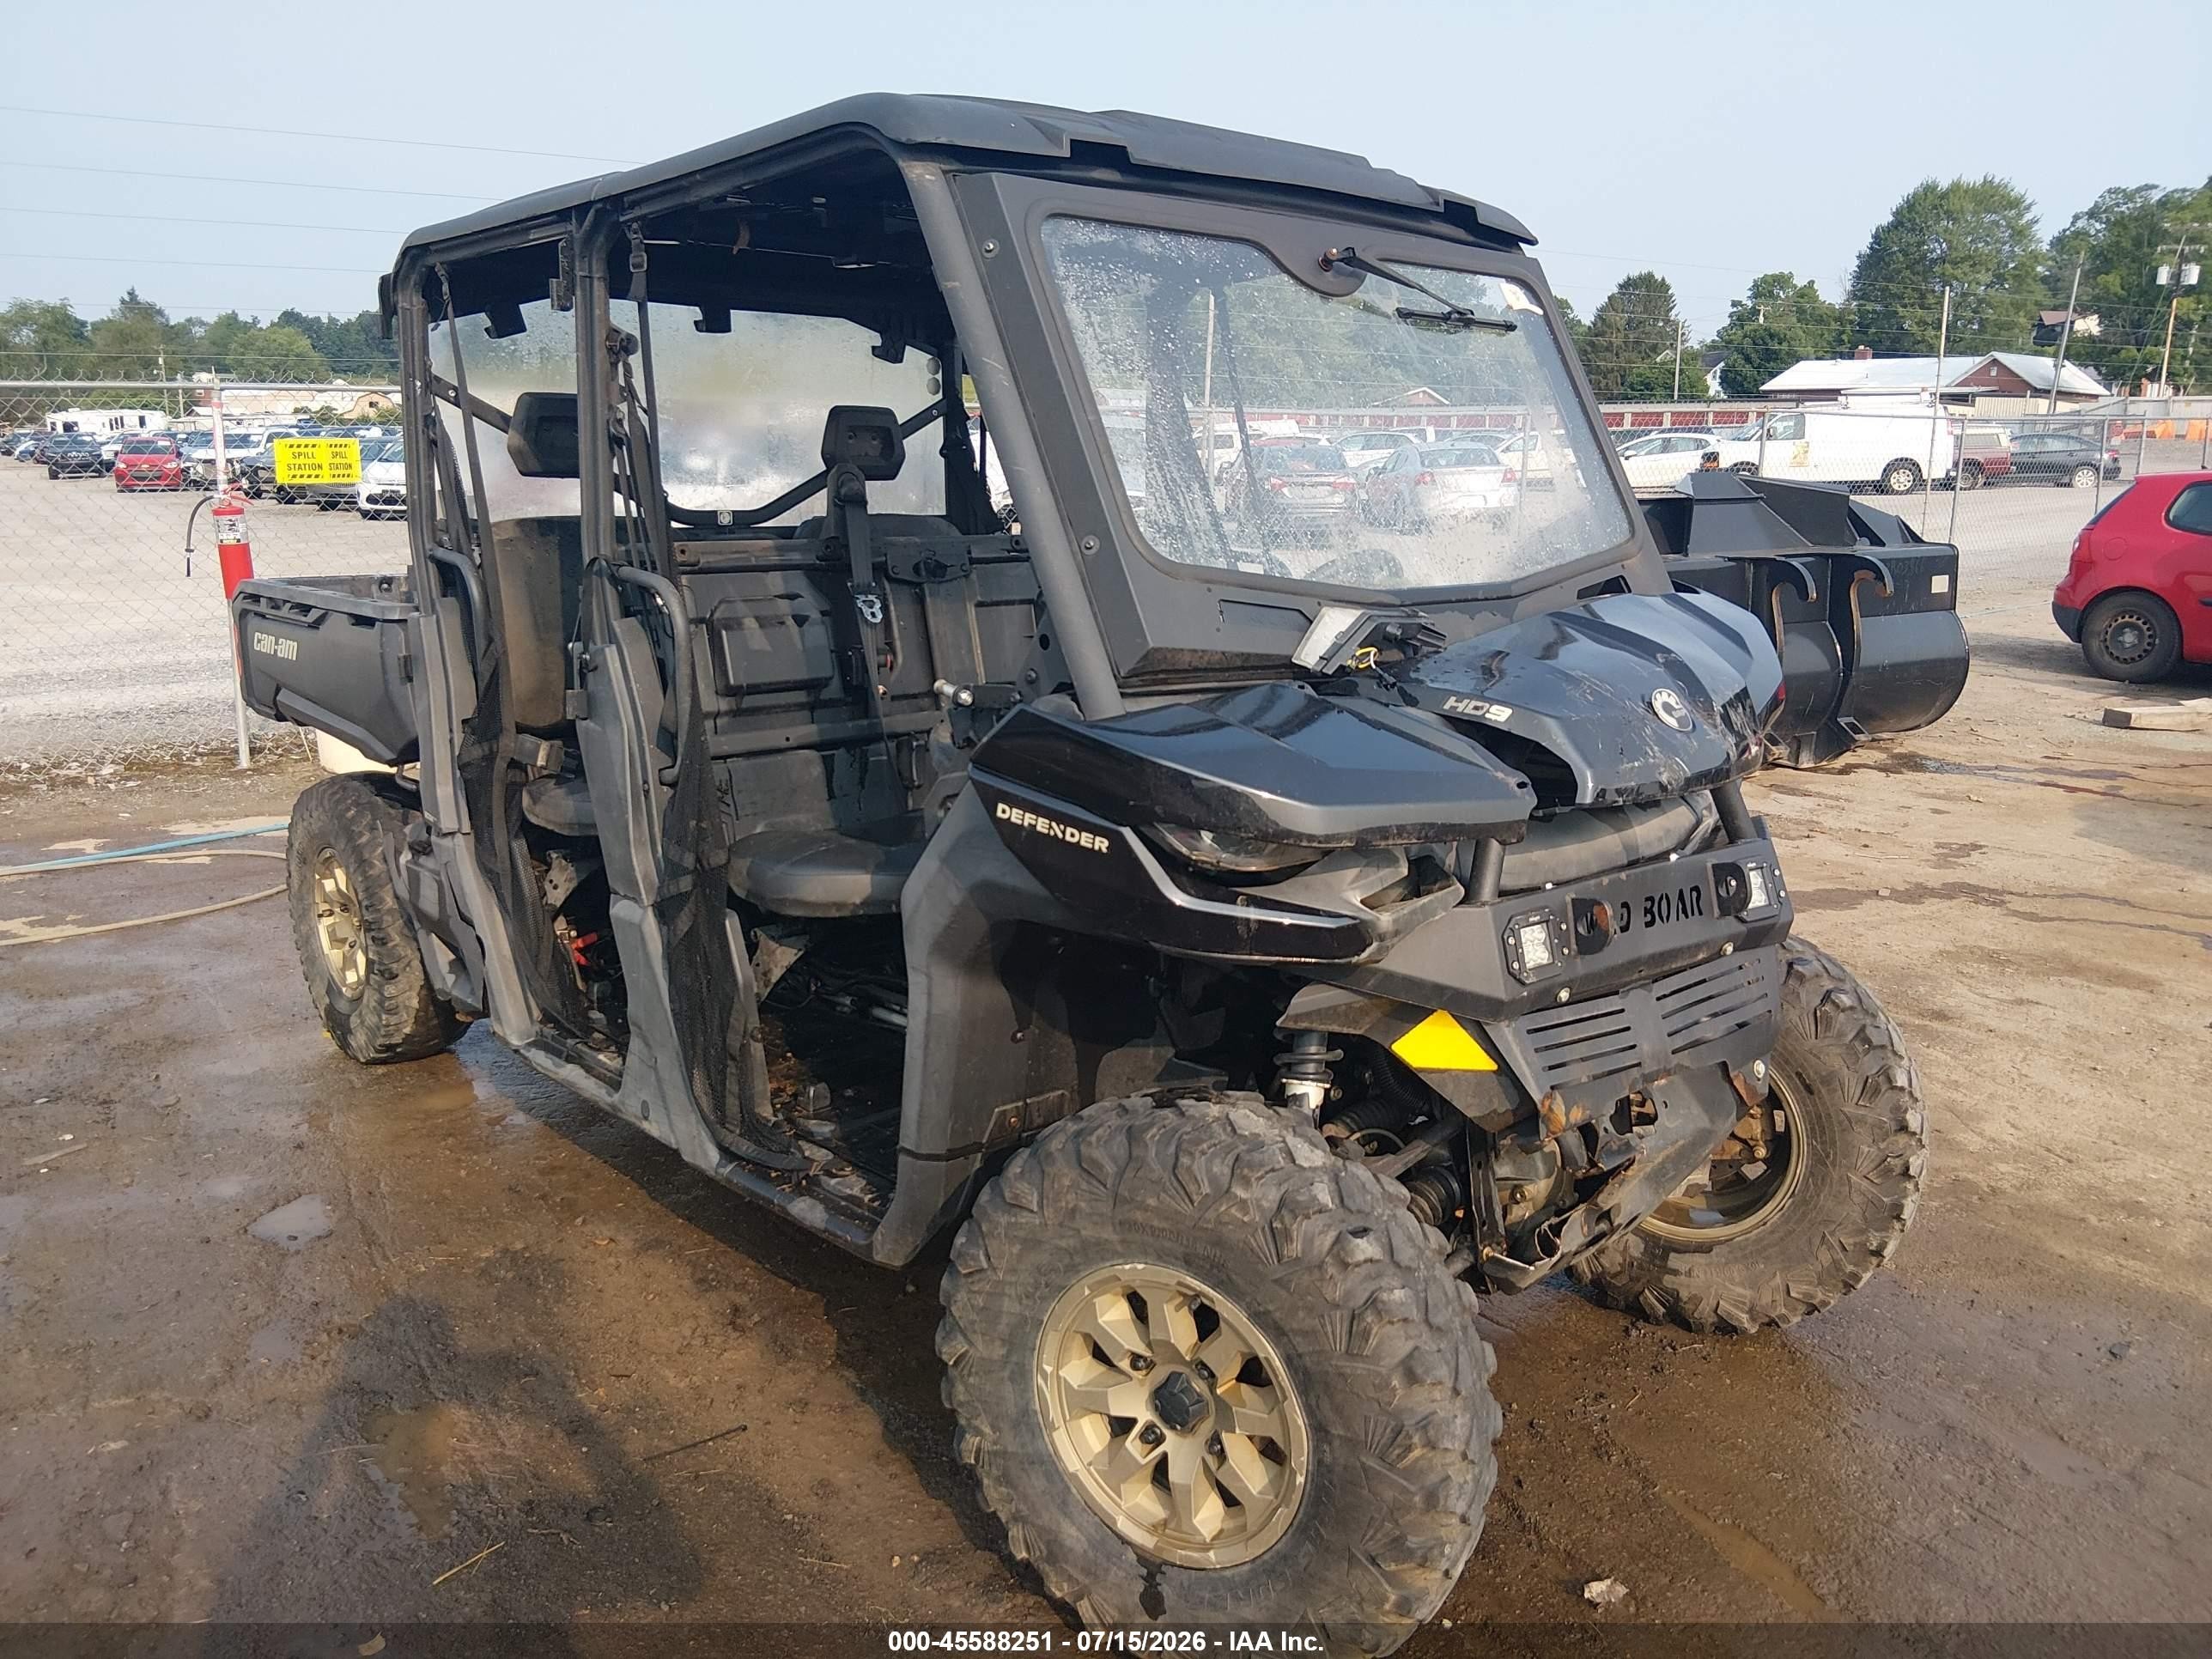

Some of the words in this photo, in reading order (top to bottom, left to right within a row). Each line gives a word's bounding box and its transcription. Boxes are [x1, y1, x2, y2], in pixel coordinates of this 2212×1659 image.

[287, 463, 323, 471] STATION
[329, 462, 352, 471] STATION
[253, 631, 298, 661] can-am
[1443, 696, 1513, 722] HD9
[996, 802, 1109, 854] DEFENDER
[1644, 884, 1704, 928] BOAR
